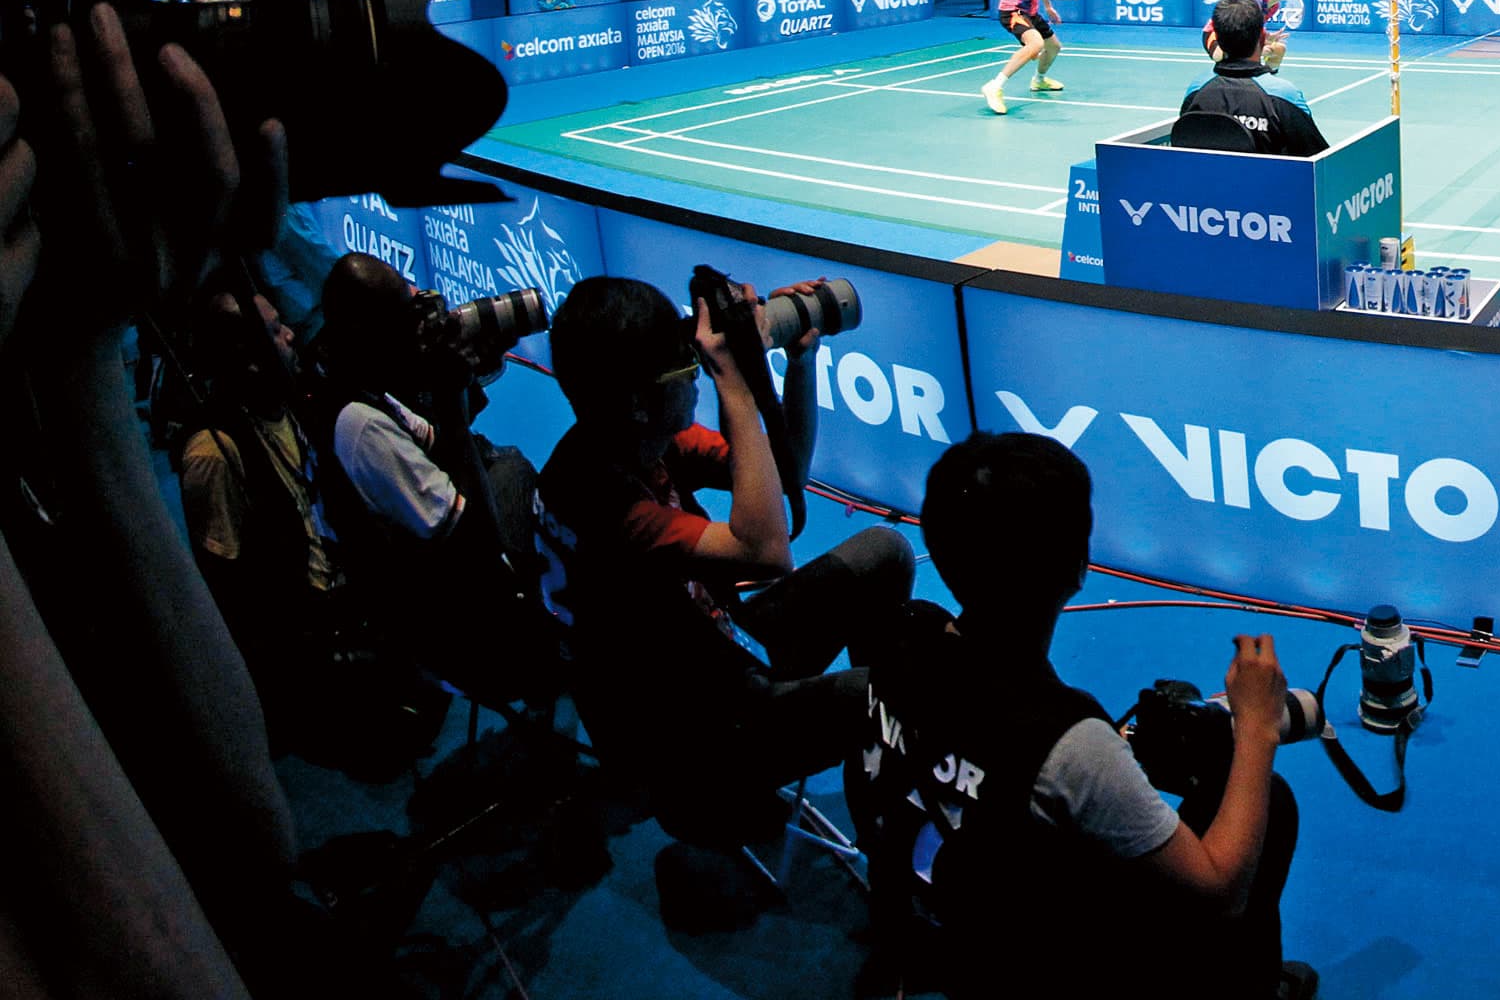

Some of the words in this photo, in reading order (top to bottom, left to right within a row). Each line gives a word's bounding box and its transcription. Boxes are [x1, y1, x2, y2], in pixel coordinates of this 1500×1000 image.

[635, 6, 676, 21] celcom
[1116, 6, 1164, 22] PLUS
[1316, 3, 1370, 14] MALAYSIA
[635, 18, 670, 33] axiata
[780, 14, 833, 36] QUARTZ
[1316, 14, 1346, 25] OPEN
[1346, 14, 1371, 25] 2016
[516, 34, 574, 58] celcom
[577, 27, 622, 48] axiata
[637, 29, 685, 46] MALAYSIA
[638, 45, 664, 60] OPEN
[665, 42, 686, 56] 2016
[1343, 172, 1394, 222] VICTOR
[1159, 202, 1294, 244] VICTOR
[424, 215, 469, 254] axiata
[343, 214, 416, 283] QUARTZ
[430, 243, 499, 296] MALAYSIA
